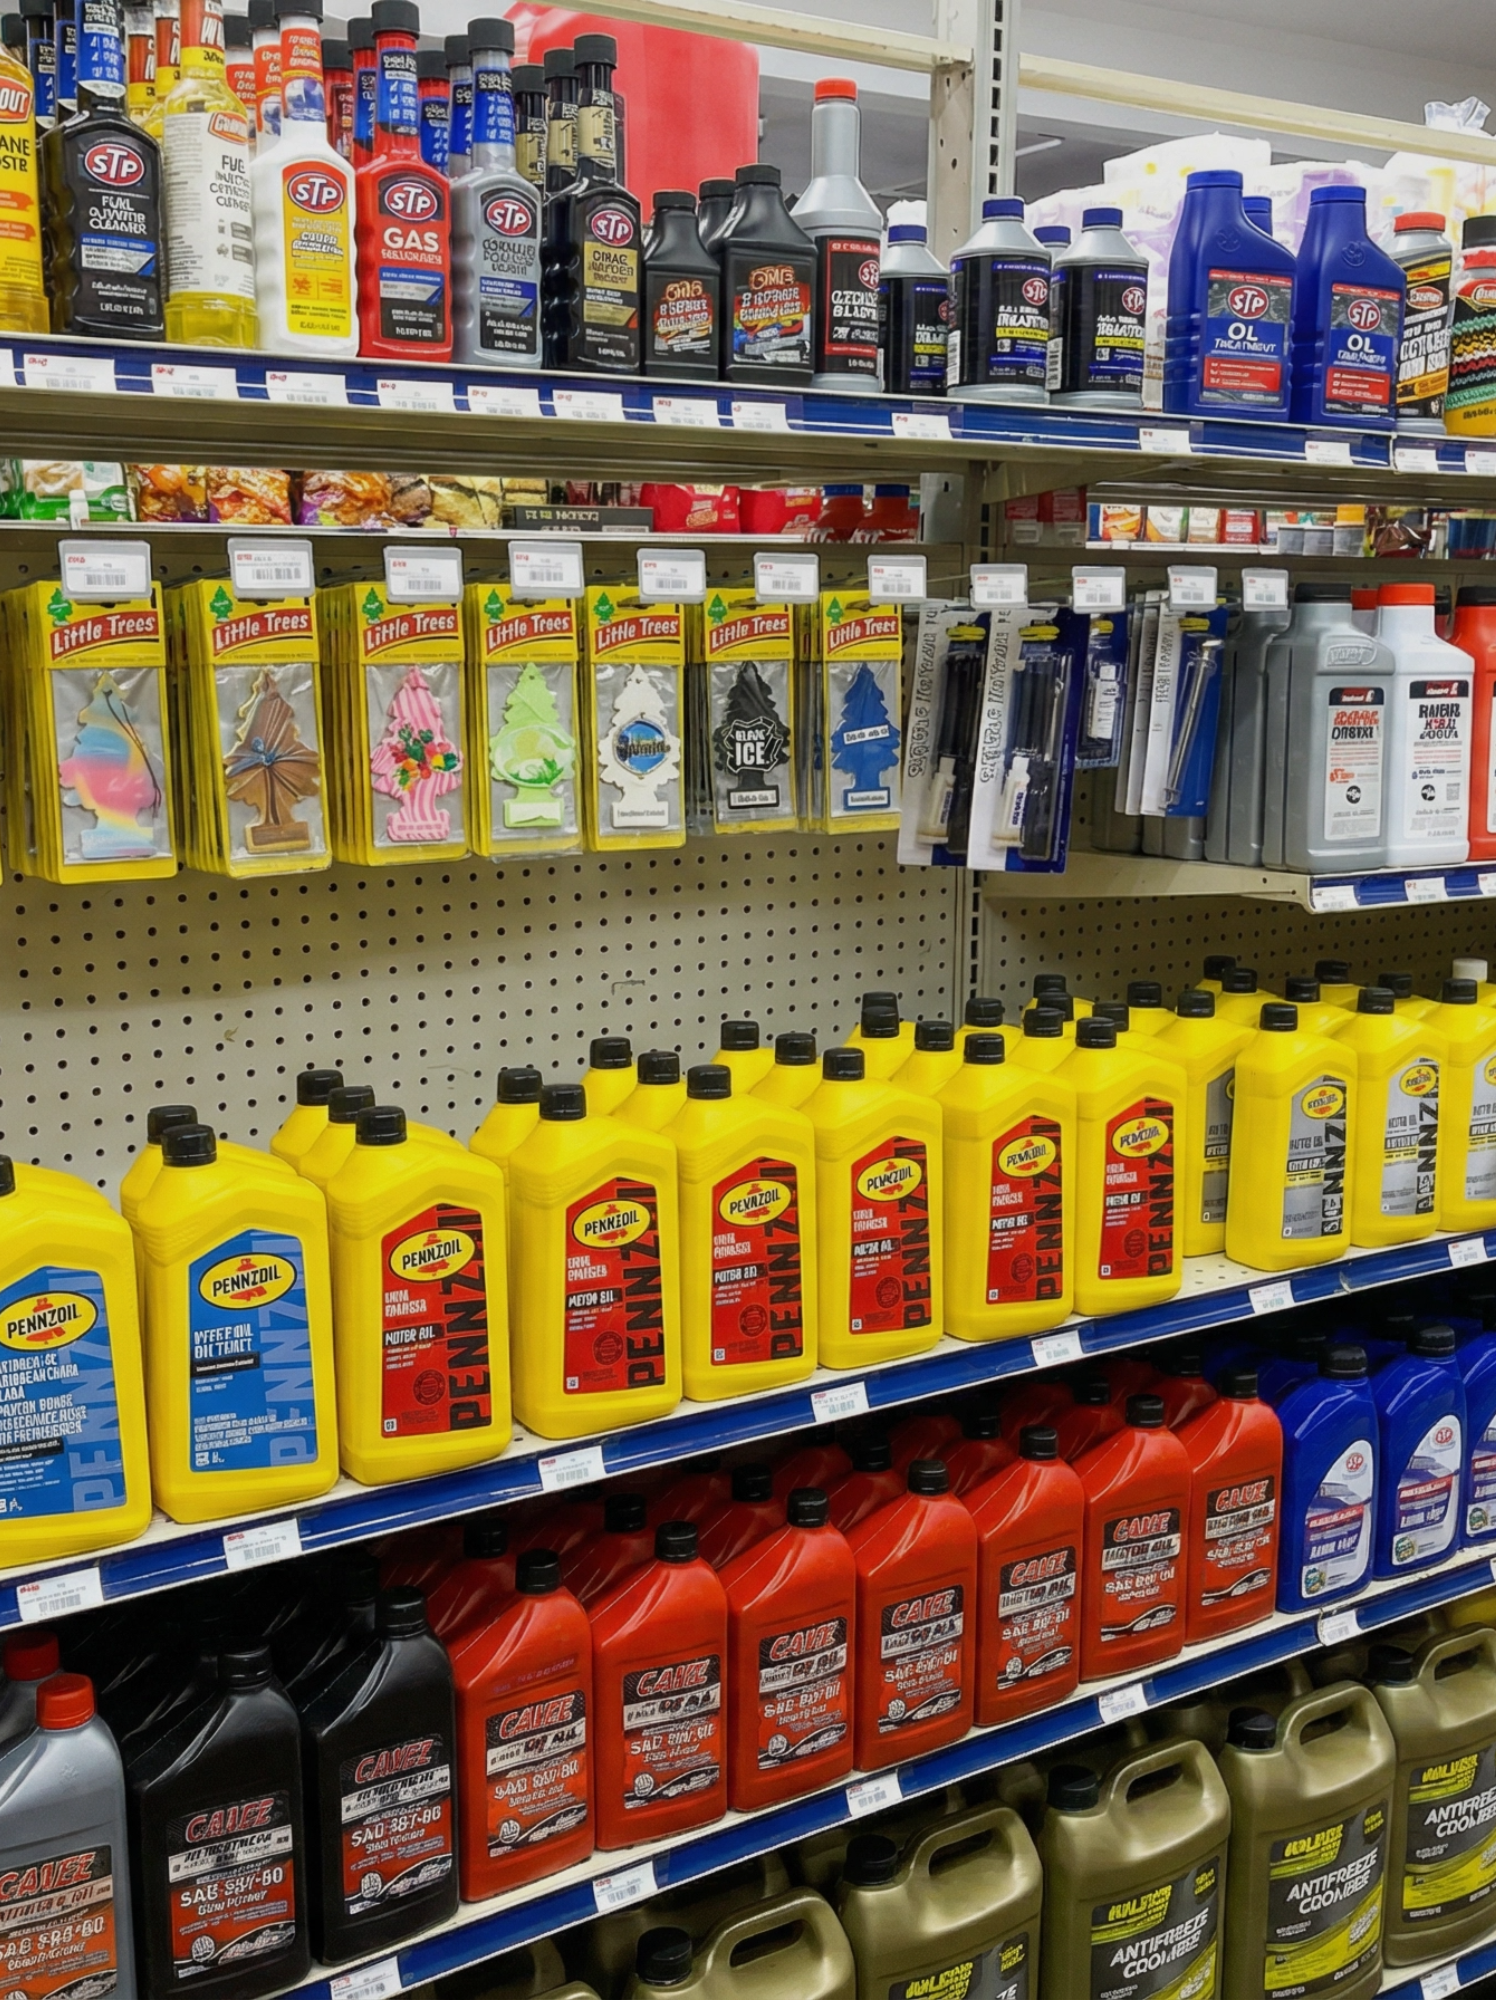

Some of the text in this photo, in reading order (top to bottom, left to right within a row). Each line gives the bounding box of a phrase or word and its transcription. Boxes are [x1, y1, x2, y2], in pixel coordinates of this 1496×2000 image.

[91, 147, 139, 180] STP
[295, 177, 338, 206] STP
[389, 186, 431, 214] STP
[491, 202, 527, 230] STP
[596, 214, 629, 241] STP
[383, 226, 440, 253] GAS
[1232, 289, 1265, 315] STP
[1350, 303, 1378, 327] STP
[53, 614, 156, 655] Little Trees
[215, 612, 309, 651] Little Trees
[366, 612, 455, 651] Little Trees
[487, 614, 570, 651] Little Trees
[597, 616, 678, 651] Little Trees
[751, 615, 788, 634] Trees
[6, 1302, 83, 1340] PENNZOIL
[1286, 1846, 1379, 1903] ANTIFREEZE
